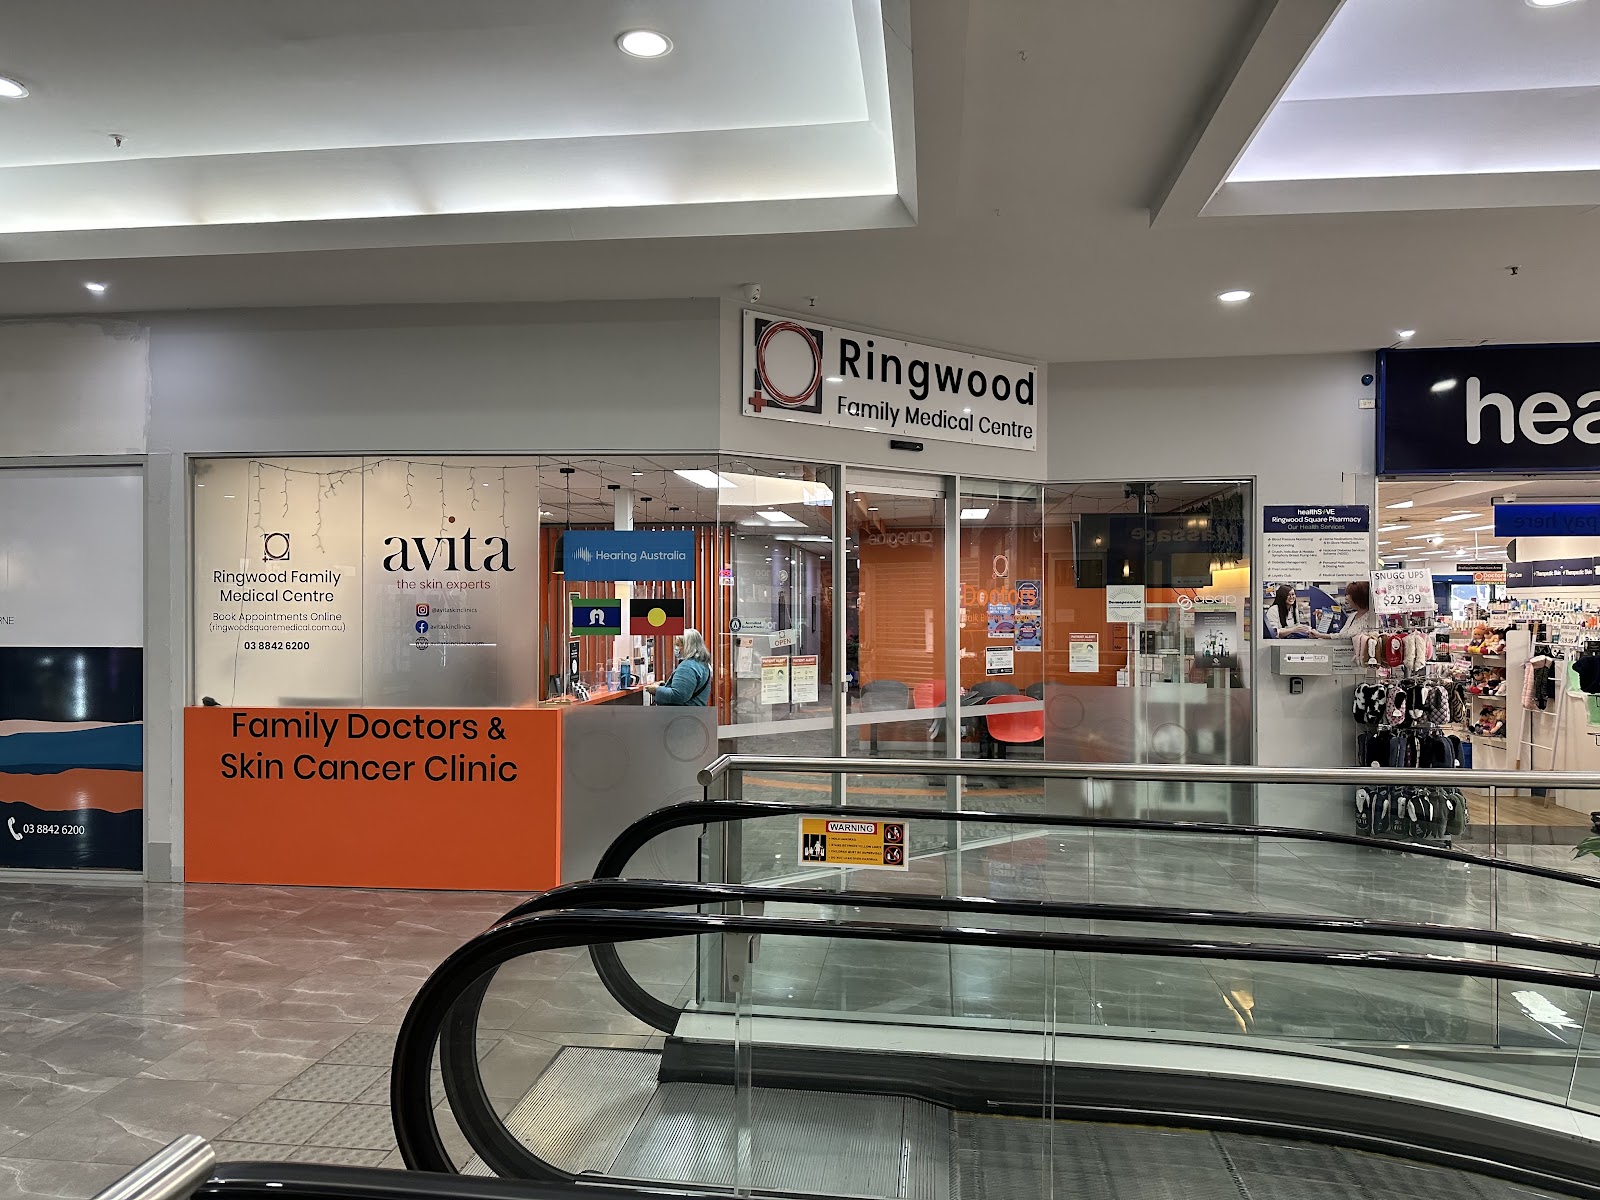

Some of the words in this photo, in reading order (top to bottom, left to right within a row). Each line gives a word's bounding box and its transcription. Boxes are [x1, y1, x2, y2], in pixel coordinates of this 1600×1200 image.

[840, 338, 1034, 406] Ringwood
[837, 396, 900, 427] Family
[905, 406, 973, 432] Medical
[979, 416, 1033, 439] Centre
[1272, 516, 1303, 524] Ringwood
[1304, 516, 1327, 524] Square
[383, 516, 517, 572] avita
[596, 550, 637, 562] Hearing
[640, 550, 686, 560] Australia
[213, 570, 287, 587] Ringwood
[291, 570, 341, 587] Family
[1375, 571, 1405, 580] SNUGG
[1408, 570, 1424, 579] UPS
[396, 579, 417, 590] the
[420, 579, 443, 590] skin
[446, 579, 491, 592] experts
[220, 589, 278, 602] Medical
[282, 589, 334, 602] Centre
[963, 584, 1036, 607] Doctors
[1194, 594, 1236, 605] asap
[1384, 593, 1421, 606] $22.99
[212, 612, 236, 621] Book
[238, 612, 308, 624] Appointments
[310, 612, 342, 621] Online
[209, 622, 346, 633] (ringwoodsquaremedical.com.au)
[430, 623, 471, 631] avitaskinclinics
[244, 641, 256, 650] 03
[258, 641, 283, 650] 8842
[285, 641, 310, 650] 6200
[774, 638, 792, 647] OPEN
[232, 711, 339, 747] Family
[347, 713, 478, 740] Doctors
[487, 716, 507, 740] &
[220, 752, 284, 780] Skin
[293, 754, 415, 781] Cancer
[424, 753, 518, 782] Clinic
[23, 823, 35, 834] 03
[36, 823, 60, 834] 8842
[61, 823, 85, 834] 6200
[830, 823, 874, 833] WARNING
